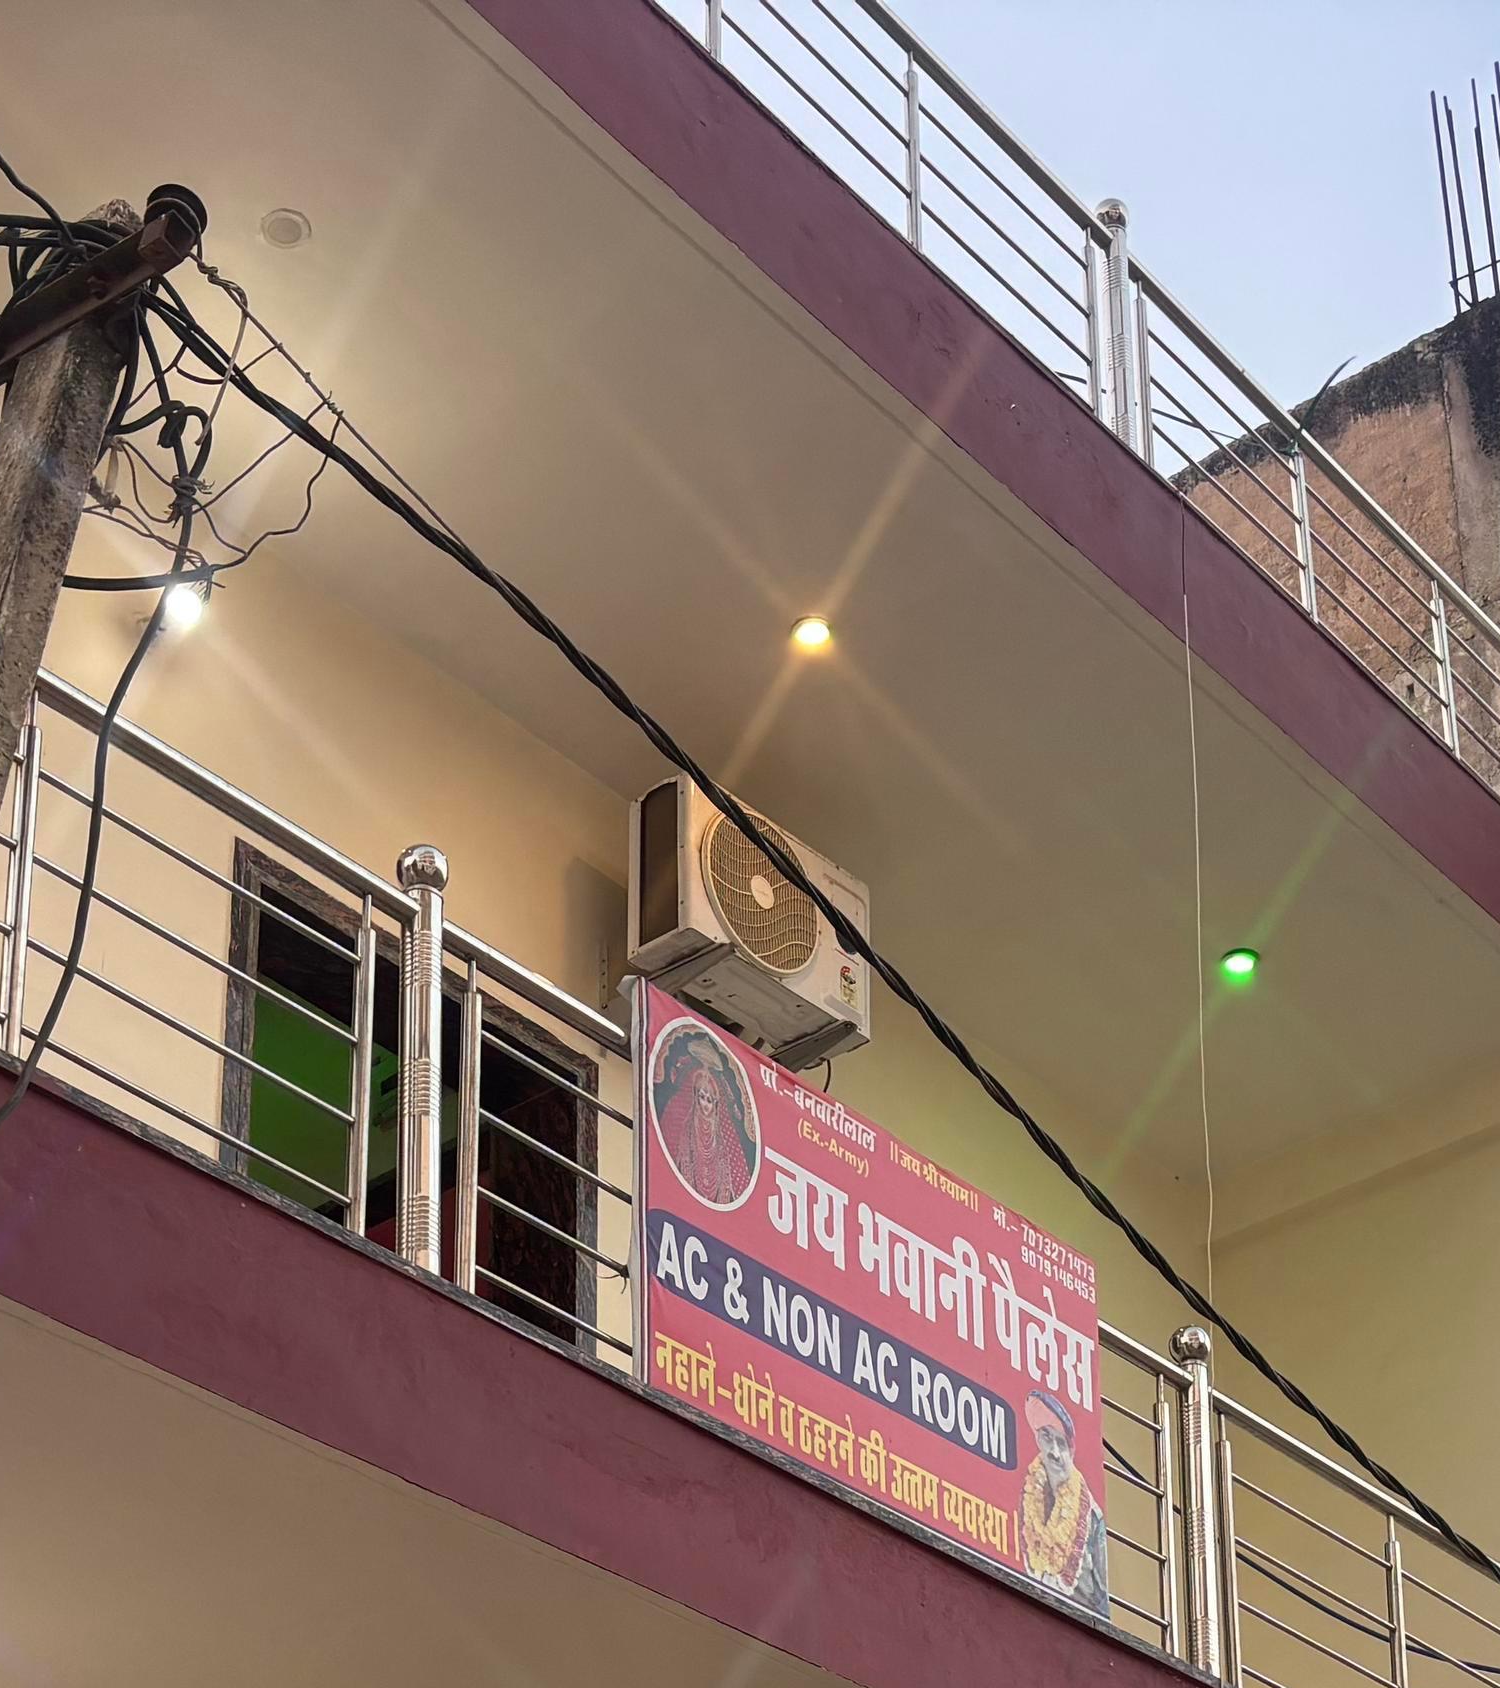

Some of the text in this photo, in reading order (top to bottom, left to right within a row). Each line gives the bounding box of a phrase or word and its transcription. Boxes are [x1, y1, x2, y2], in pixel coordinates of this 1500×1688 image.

[797, 1118, 869, 1178] (Ex.-Army)
[764, 1146, 1096, 1413] जय भवानी पैलेस
[1021, 1246, 1097, 1305] 9079146453
[656, 1220, 1008, 1464] AC & NON AC ROOM
[777, 1394, 795, 1448] व
[796, 1402, 855, 1478] ठहरने
[858, 1428, 887, 1495] की
[889, 1451, 940, 1521] उत्तम
